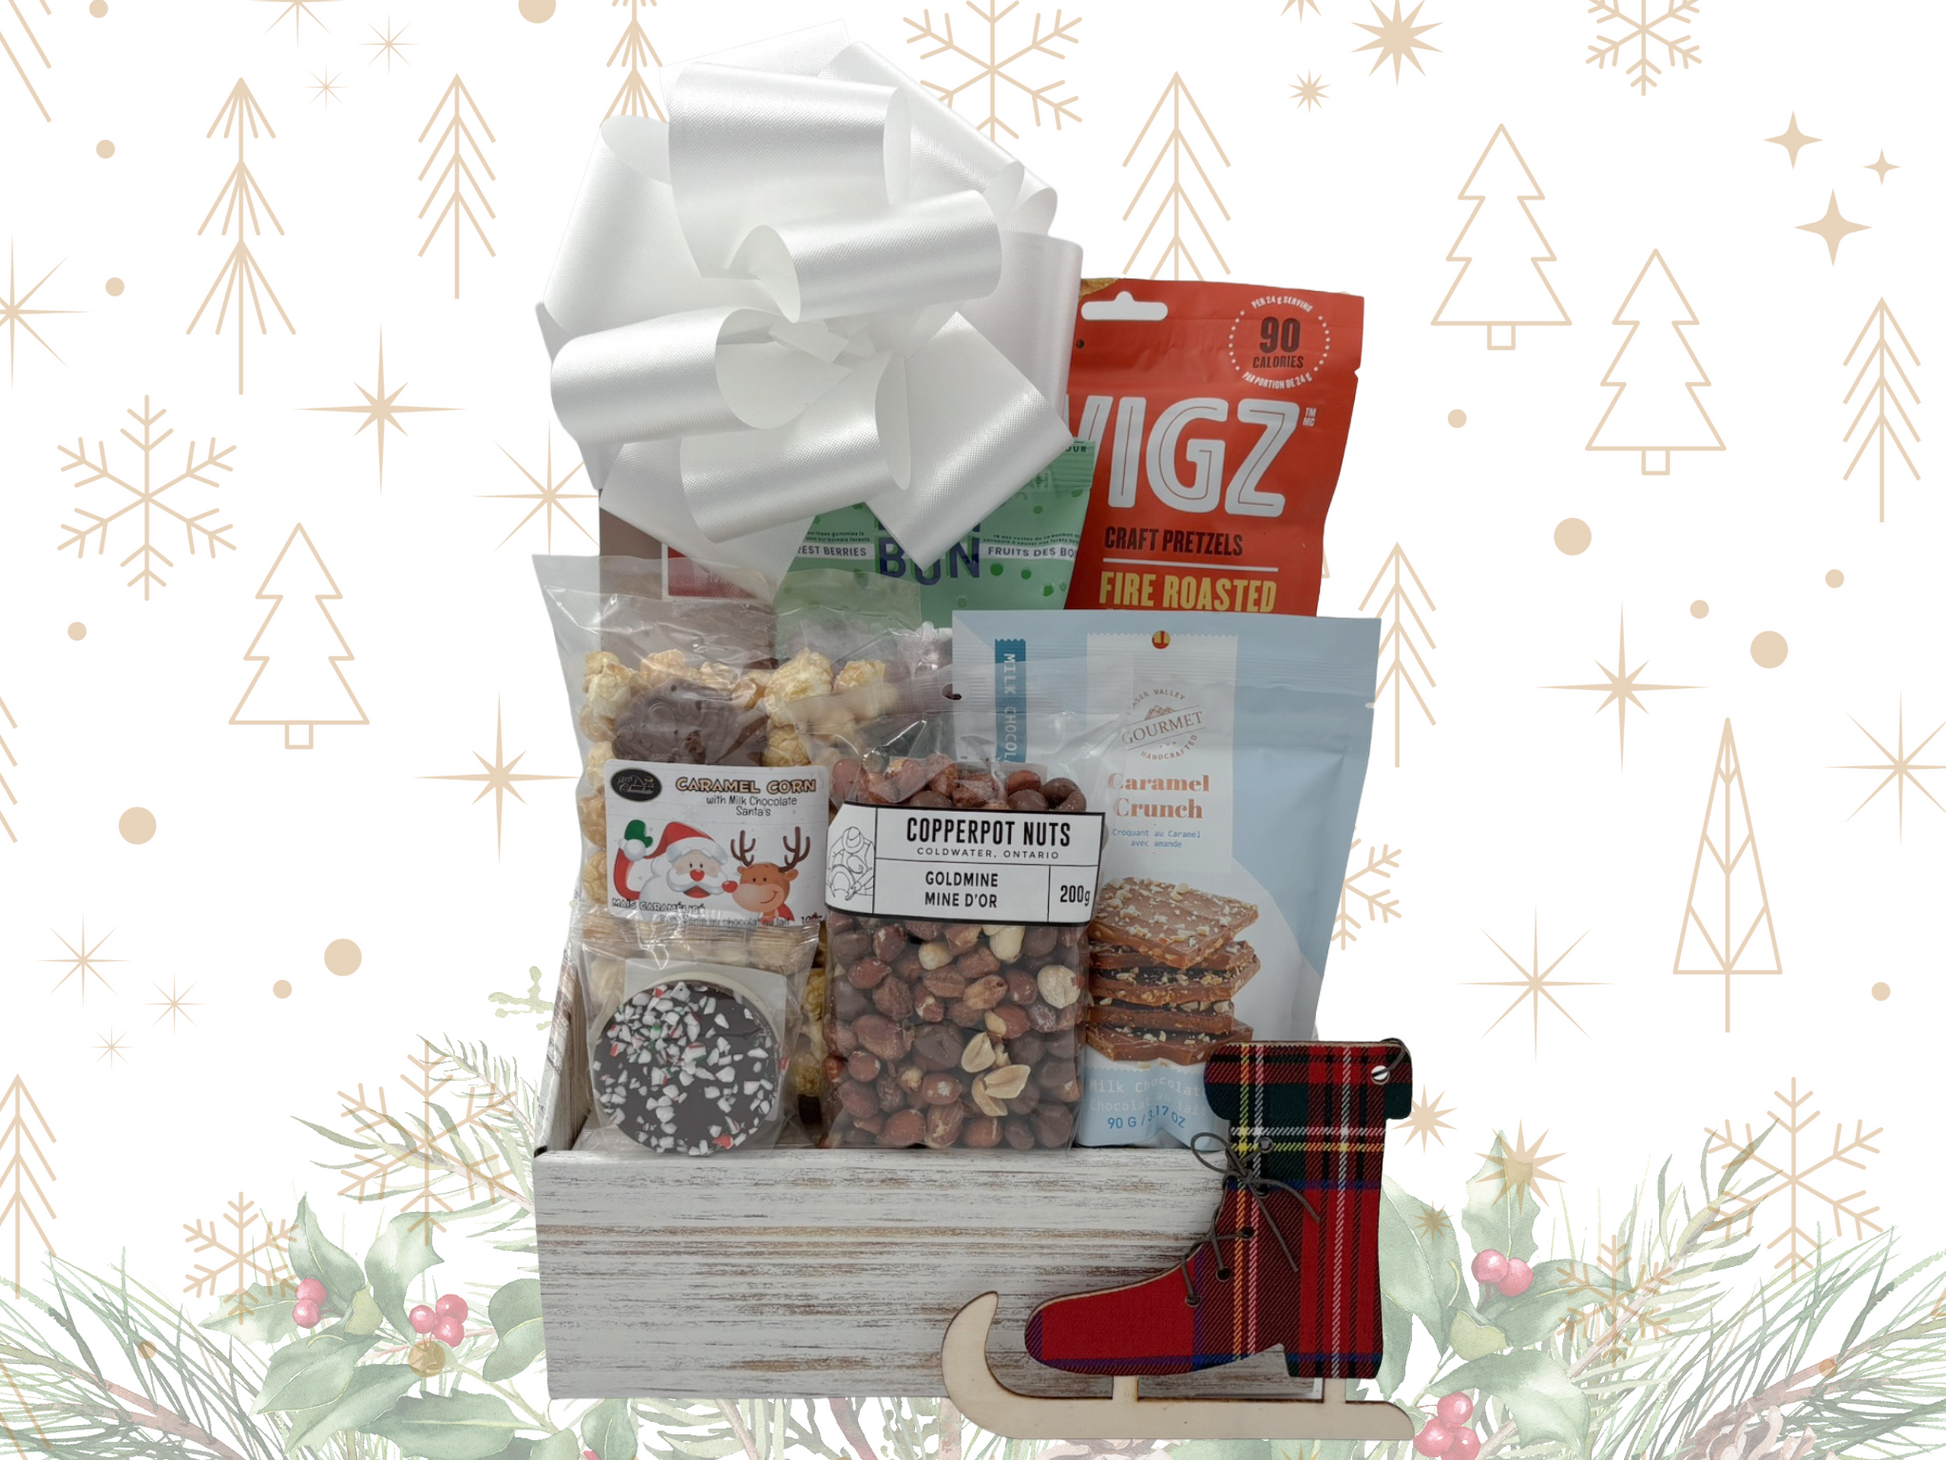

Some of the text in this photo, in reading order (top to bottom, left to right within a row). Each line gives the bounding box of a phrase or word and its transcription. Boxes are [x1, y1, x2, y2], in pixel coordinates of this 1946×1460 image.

[1251, 297, 1266, 309] PER
[1266, 295, 1276, 305] 24
[1283, 296, 1313, 313] SERVING
[1259, 316, 1301, 354] 90
[1252, 355, 1304, 369] CALORIES
[1242, 371, 1256, 383] PAR
[1254, 374, 1285, 390] PORTION
[1286, 378, 1296, 389] DE
[1295, 374, 1306, 385] 24
[1304, 407, 1316, 417] TM
[1303, 417, 1315, 427] MC
[1104, 526, 1243, 556] CRAFT PRETZELS
[823, 546, 867, 557] BERRIES
[988, 546, 1077, 558] FRUITS DES BO
[1099, 571, 1277, 613] FIRE ROASTED
[1153, 688, 1186, 701] VALLEY
[1003, 653, 1018, 763] MILK CHOCOL
[1121, 711, 1203, 745] GOURMET
[1140, 734, 1198, 760] HANDCRAFTED
[675, 776, 761, 794] CARAMEL
[766, 778, 816, 794] CORN
[1107, 772, 1210, 791] Caramel
[706, 795, 797, 806] with Milk Chocolate
[1113, 797, 1203, 819] Crunch
[736, 805, 771, 816] Santa's
[906, 816, 1071, 847] COPPERPOT NUTS
[1112, 828, 1150, 837] Croquant
[1168, 830, 1201, 839] Caramel
[1154, 840, 1182, 848] amande
[917, 847, 1059, 860] COLDWATER, ONTARIO
[925, 871, 998, 887] GOLDMINE
[925, 891, 997, 908] MINE D'OR
[1060, 885, 1090, 906] 200g
[1090, 1078, 1125, 1093] Milk
[1107, 1117, 1123, 1129] 90
[1128, 1116, 1137, 1128] G
[1147, 1105, 1169, 1121] 3.17
[1171, 1111, 1186, 1128] OZ
